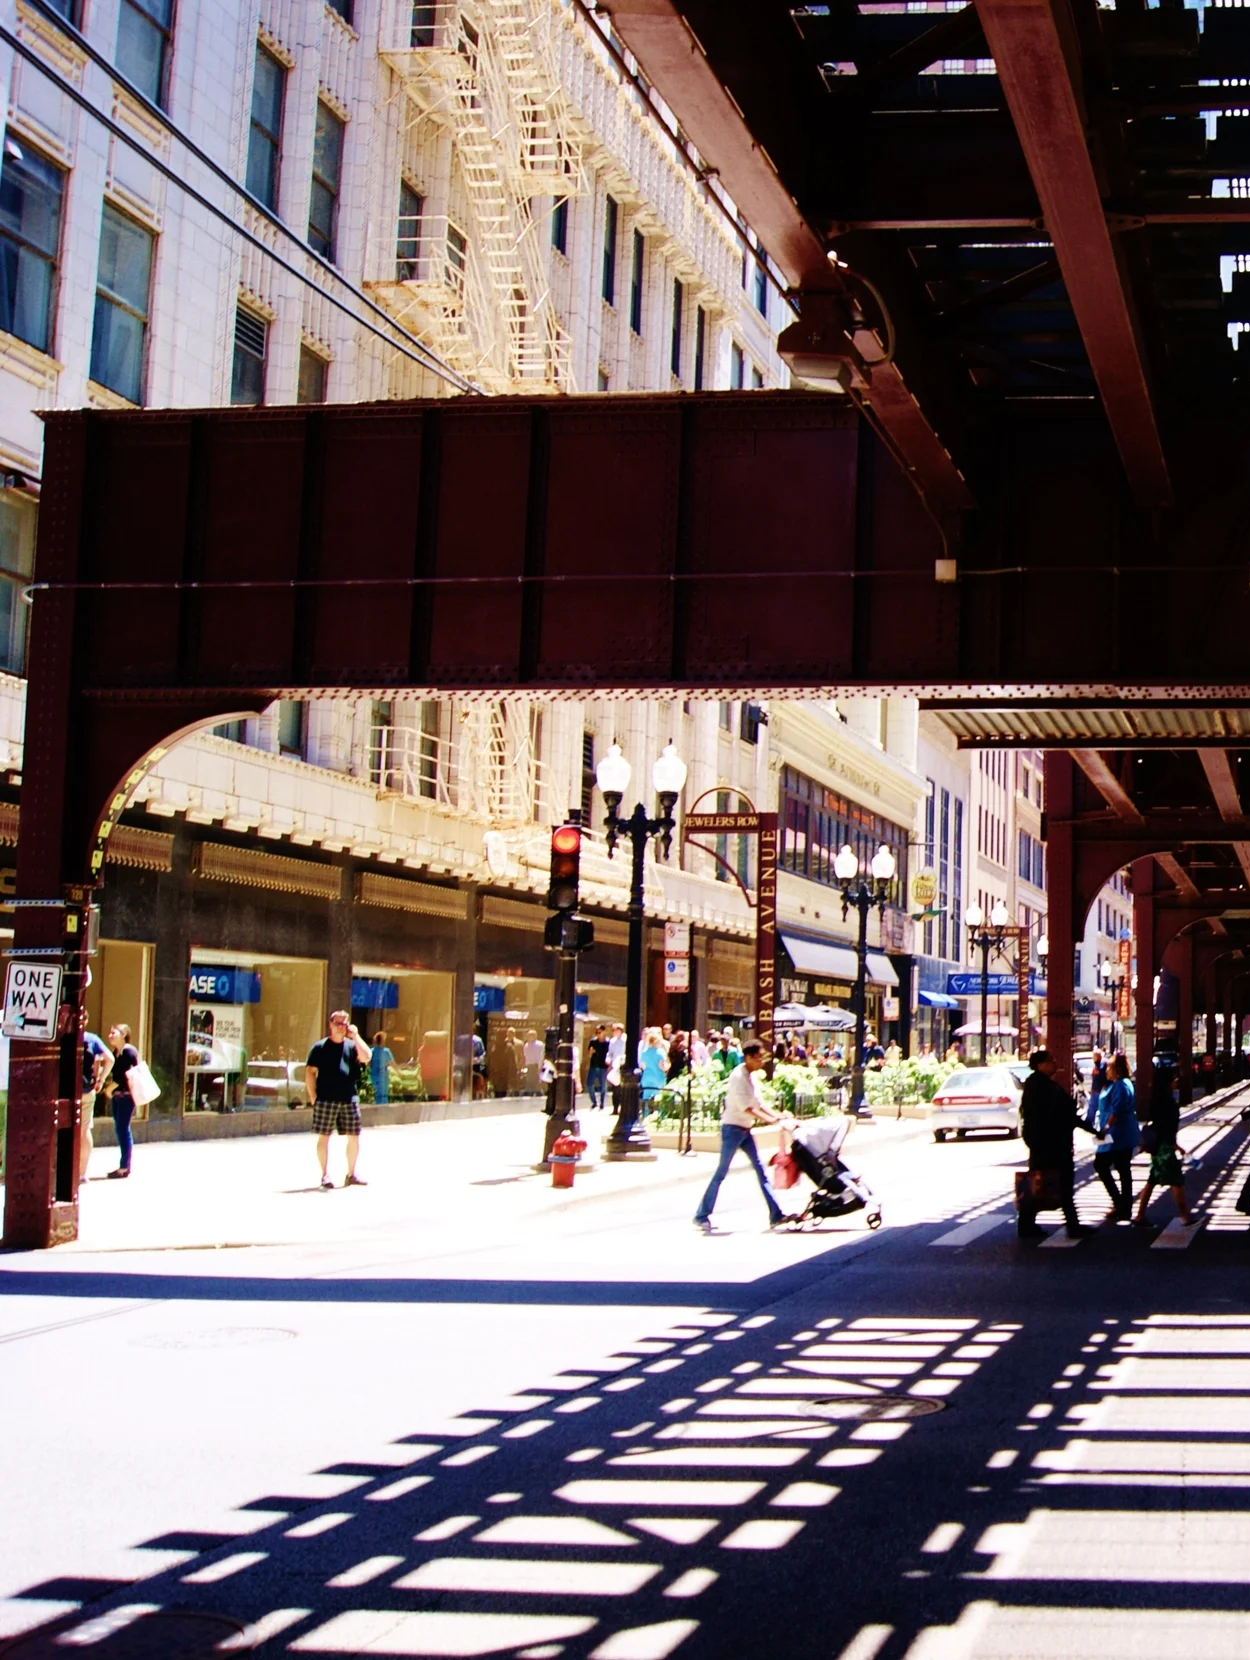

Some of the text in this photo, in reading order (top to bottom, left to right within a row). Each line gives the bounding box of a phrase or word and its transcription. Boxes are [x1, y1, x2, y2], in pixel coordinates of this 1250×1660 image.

[684, 816, 759, 827] JEWELERS ROW
[760, 830, 775, 934] AVENUE
[14, 969, 54, 989] ONE
[12, 991, 53, 1009] WAY
